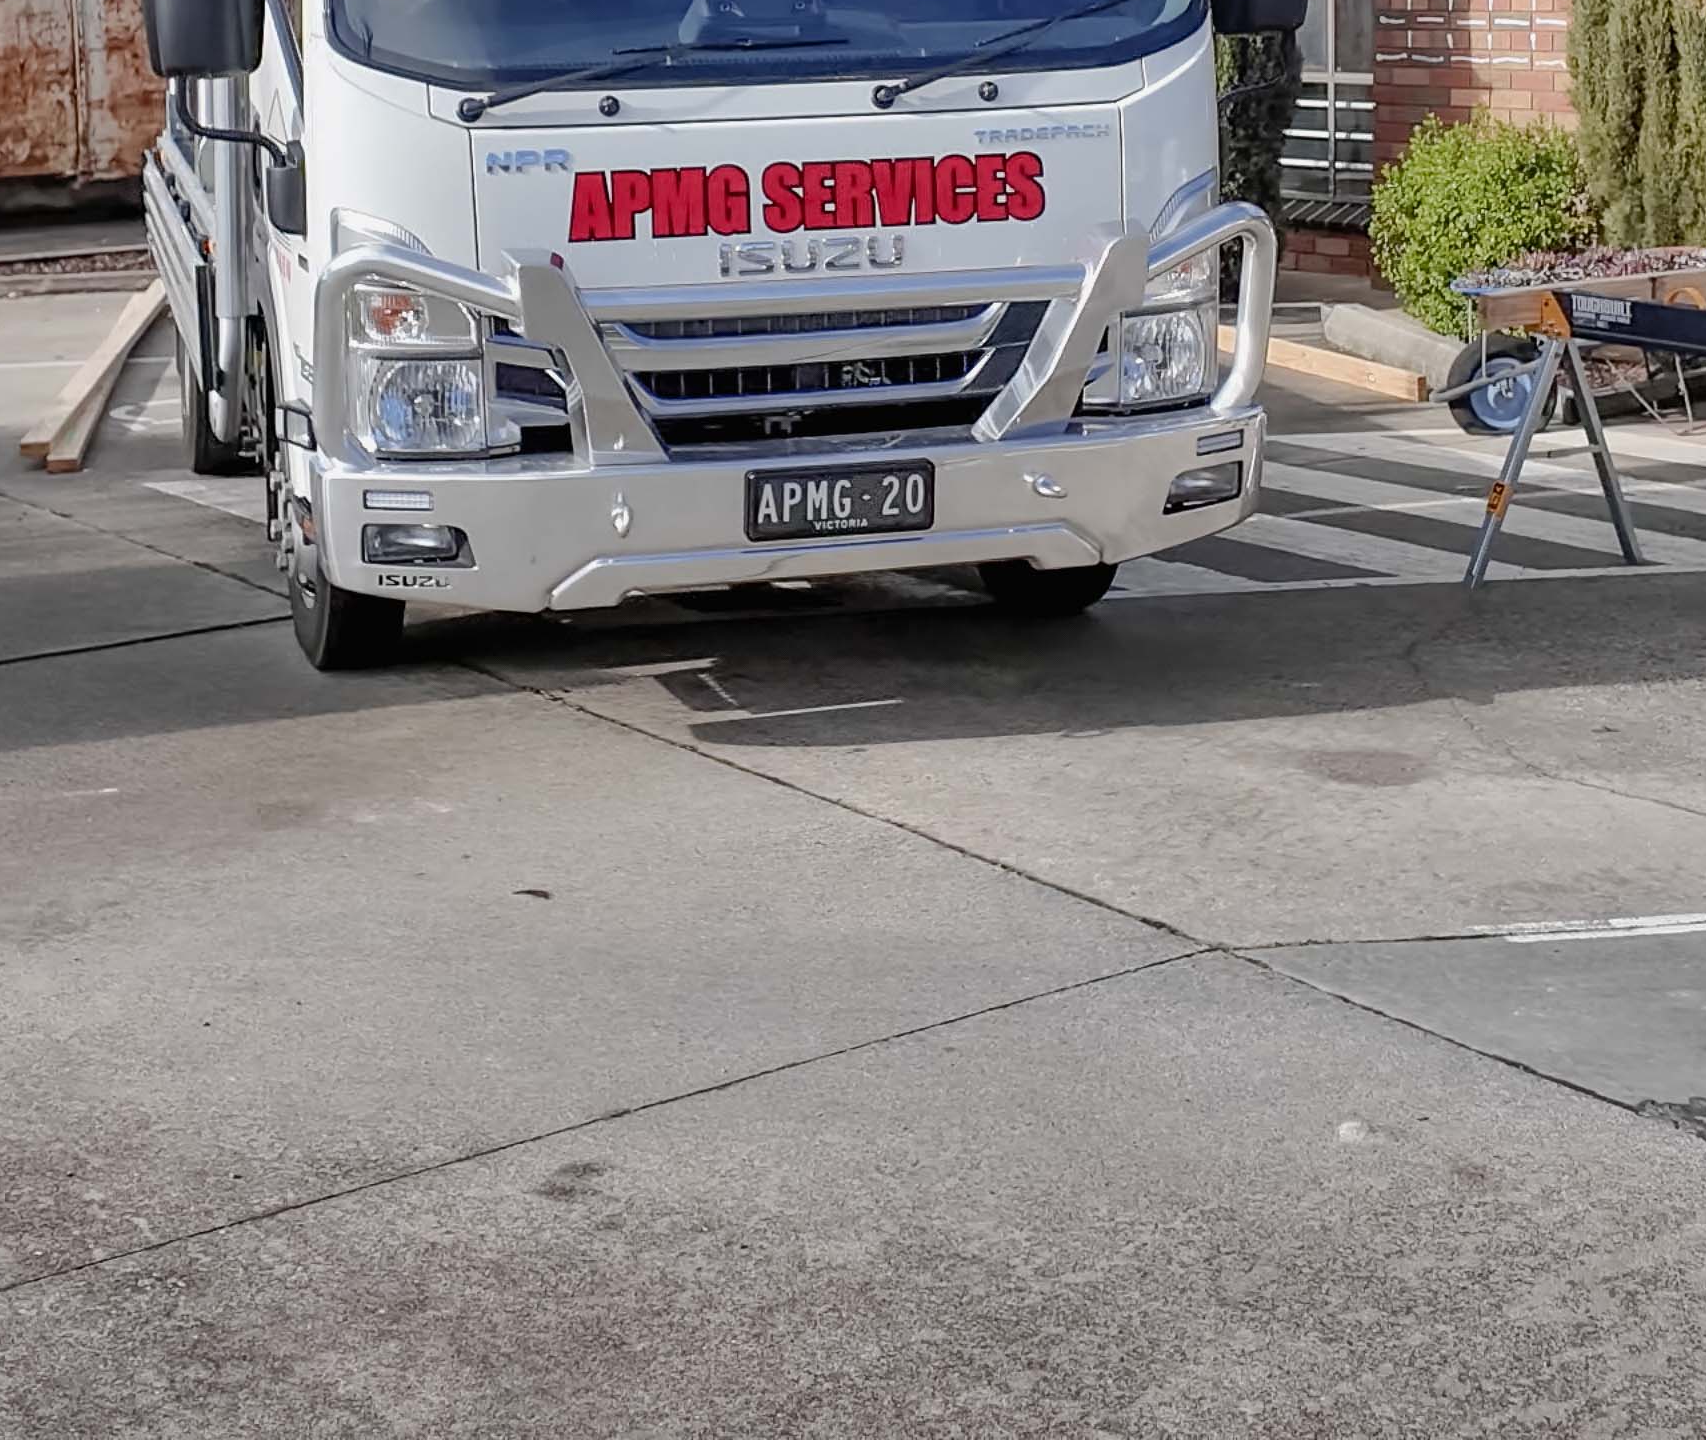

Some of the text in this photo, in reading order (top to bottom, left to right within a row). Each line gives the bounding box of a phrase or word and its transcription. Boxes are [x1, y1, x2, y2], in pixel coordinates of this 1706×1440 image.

[486, 148, 573, 175] NPR
[568, 151, 1046, 243] APMG SERVICES
[718, 234, 905, 278] ISUZU
[757, 473, 925, 524] APMG 20
[814, 518, 868, 531] VICTORIA
[378, 574, 450, 588] ISUZU
